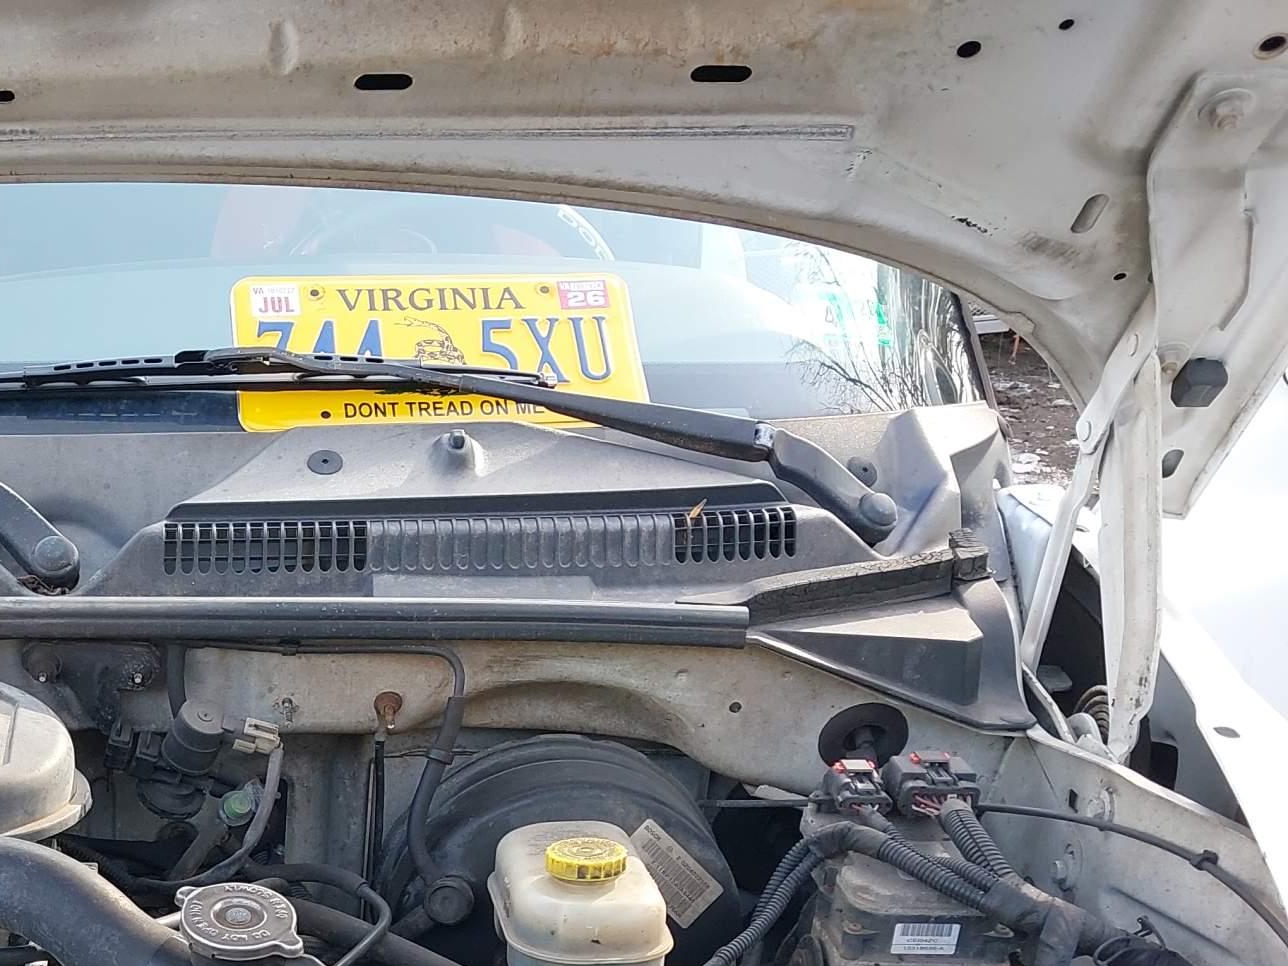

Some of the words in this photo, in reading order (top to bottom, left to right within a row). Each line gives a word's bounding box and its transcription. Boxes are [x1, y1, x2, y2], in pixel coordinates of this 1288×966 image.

[258, 296, 295, 313] JUL
[336, 286, 525, 312] VIRGINIA
[567, 290, 607, 306] 26
[481, 316, 611, 382] 5XU
[344, 401, 399, 418] DONT
[404, 399, 474, 417] TREAD
[479, 398, 508, 416] ON
